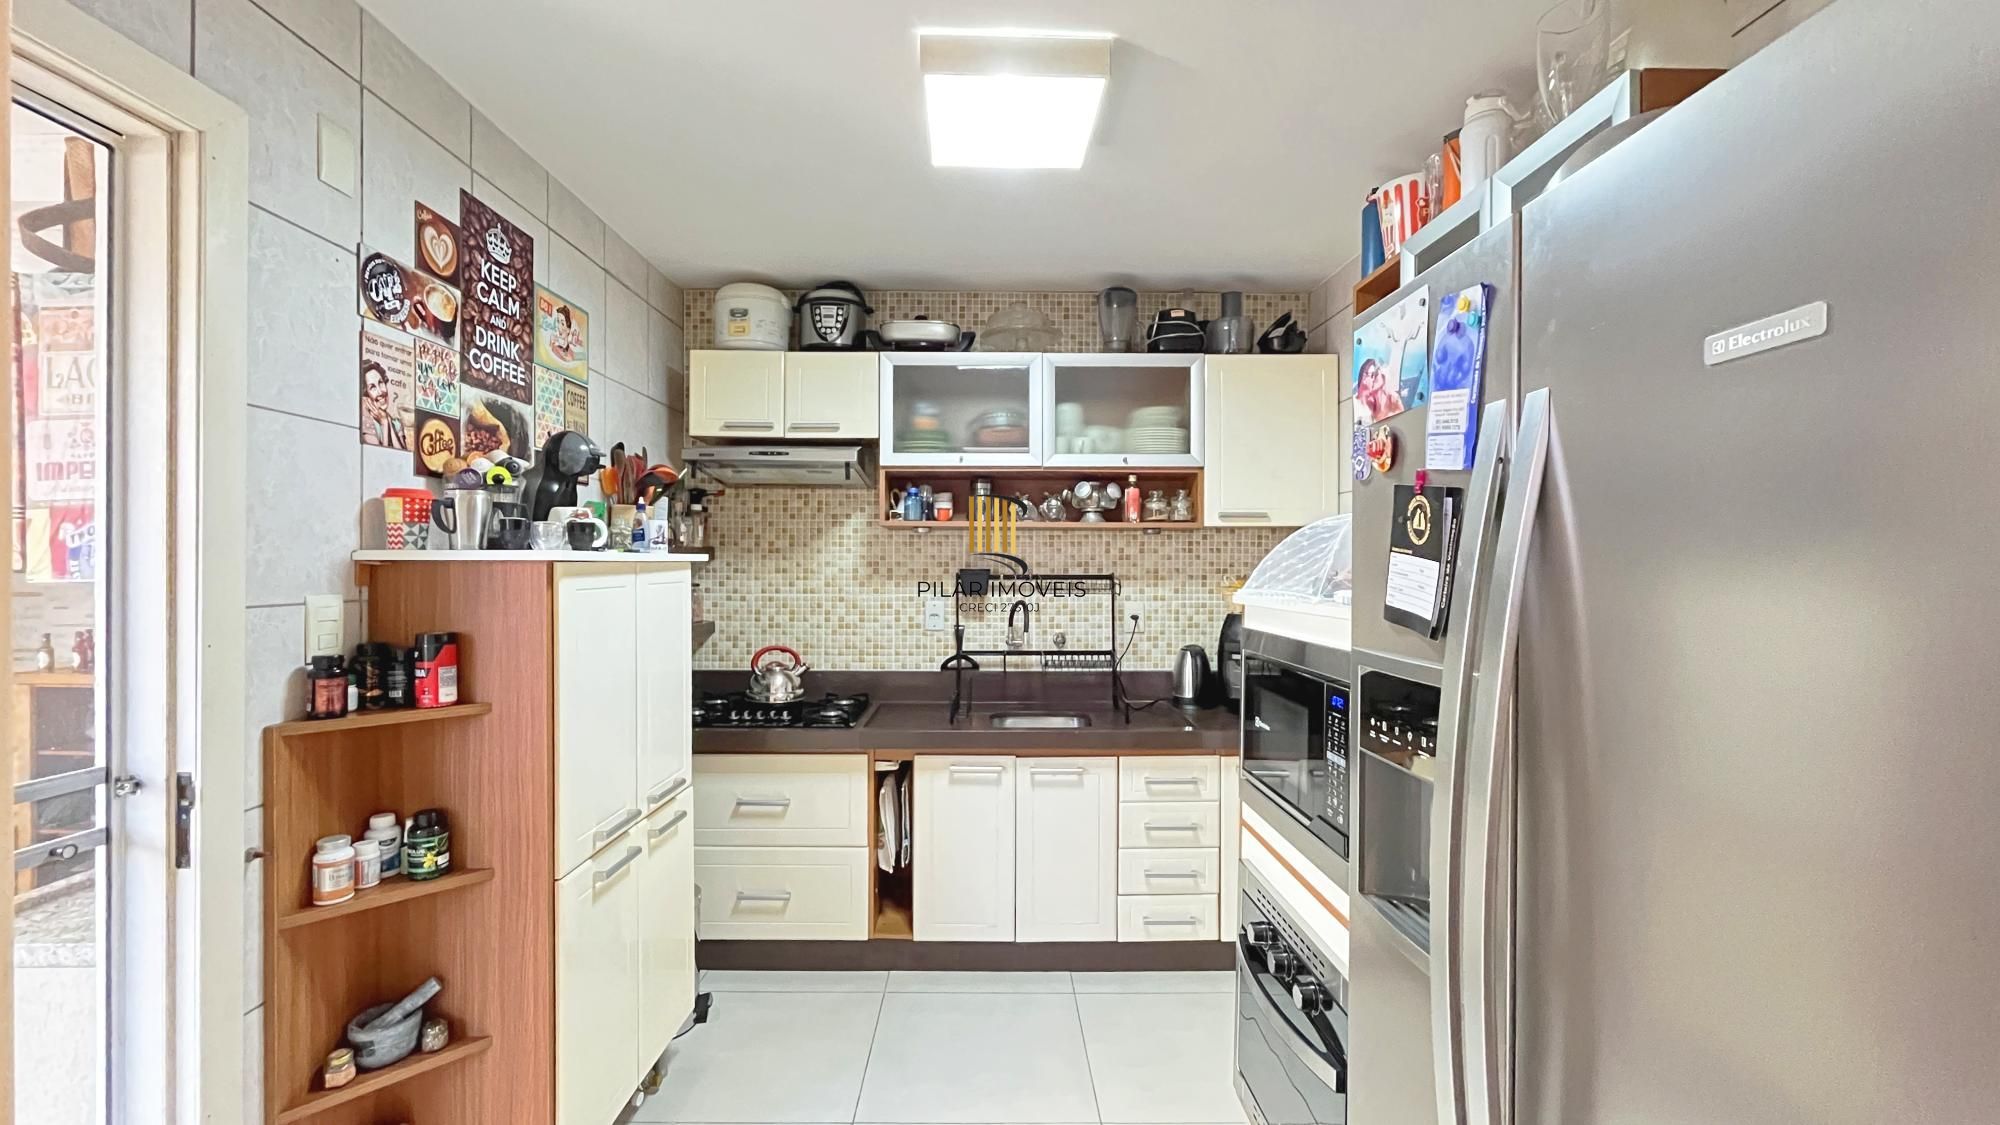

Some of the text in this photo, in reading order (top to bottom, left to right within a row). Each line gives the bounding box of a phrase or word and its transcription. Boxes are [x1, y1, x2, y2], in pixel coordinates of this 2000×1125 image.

[481, 258, 517, 293] KEEP
[476, 281, 520, 320] CALM
[490, 314, 507, 330] AND
[1728, 317, 1811, 351] Electrolux
[475, 324, 520, 363] DRINK
[469, 347, 526, 387] COFFEE
[567, 389, 586, 411] COFFEE
[36, 461, 96, 481] IMPE
